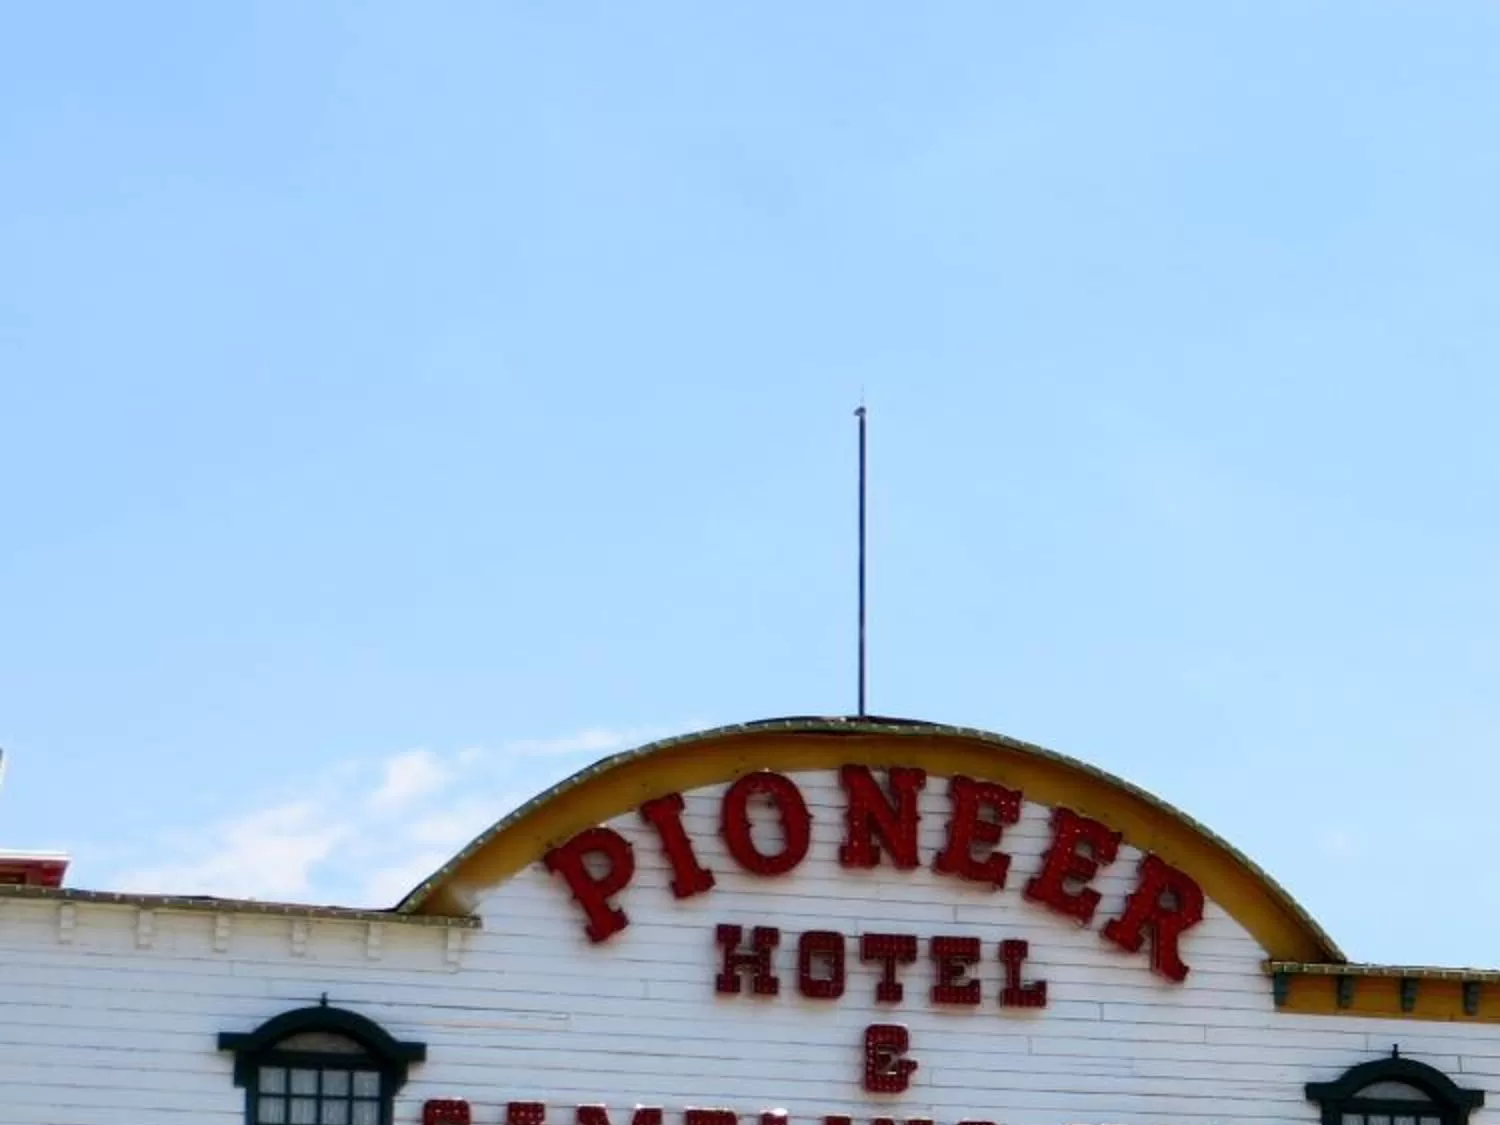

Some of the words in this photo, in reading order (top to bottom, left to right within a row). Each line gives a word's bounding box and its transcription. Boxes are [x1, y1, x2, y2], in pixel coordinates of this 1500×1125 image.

[543, 764, 1206, 982] PIONEER
[715, 924, 1048, 1008] HOTEL
[862, 1024, 918, 1093] &
